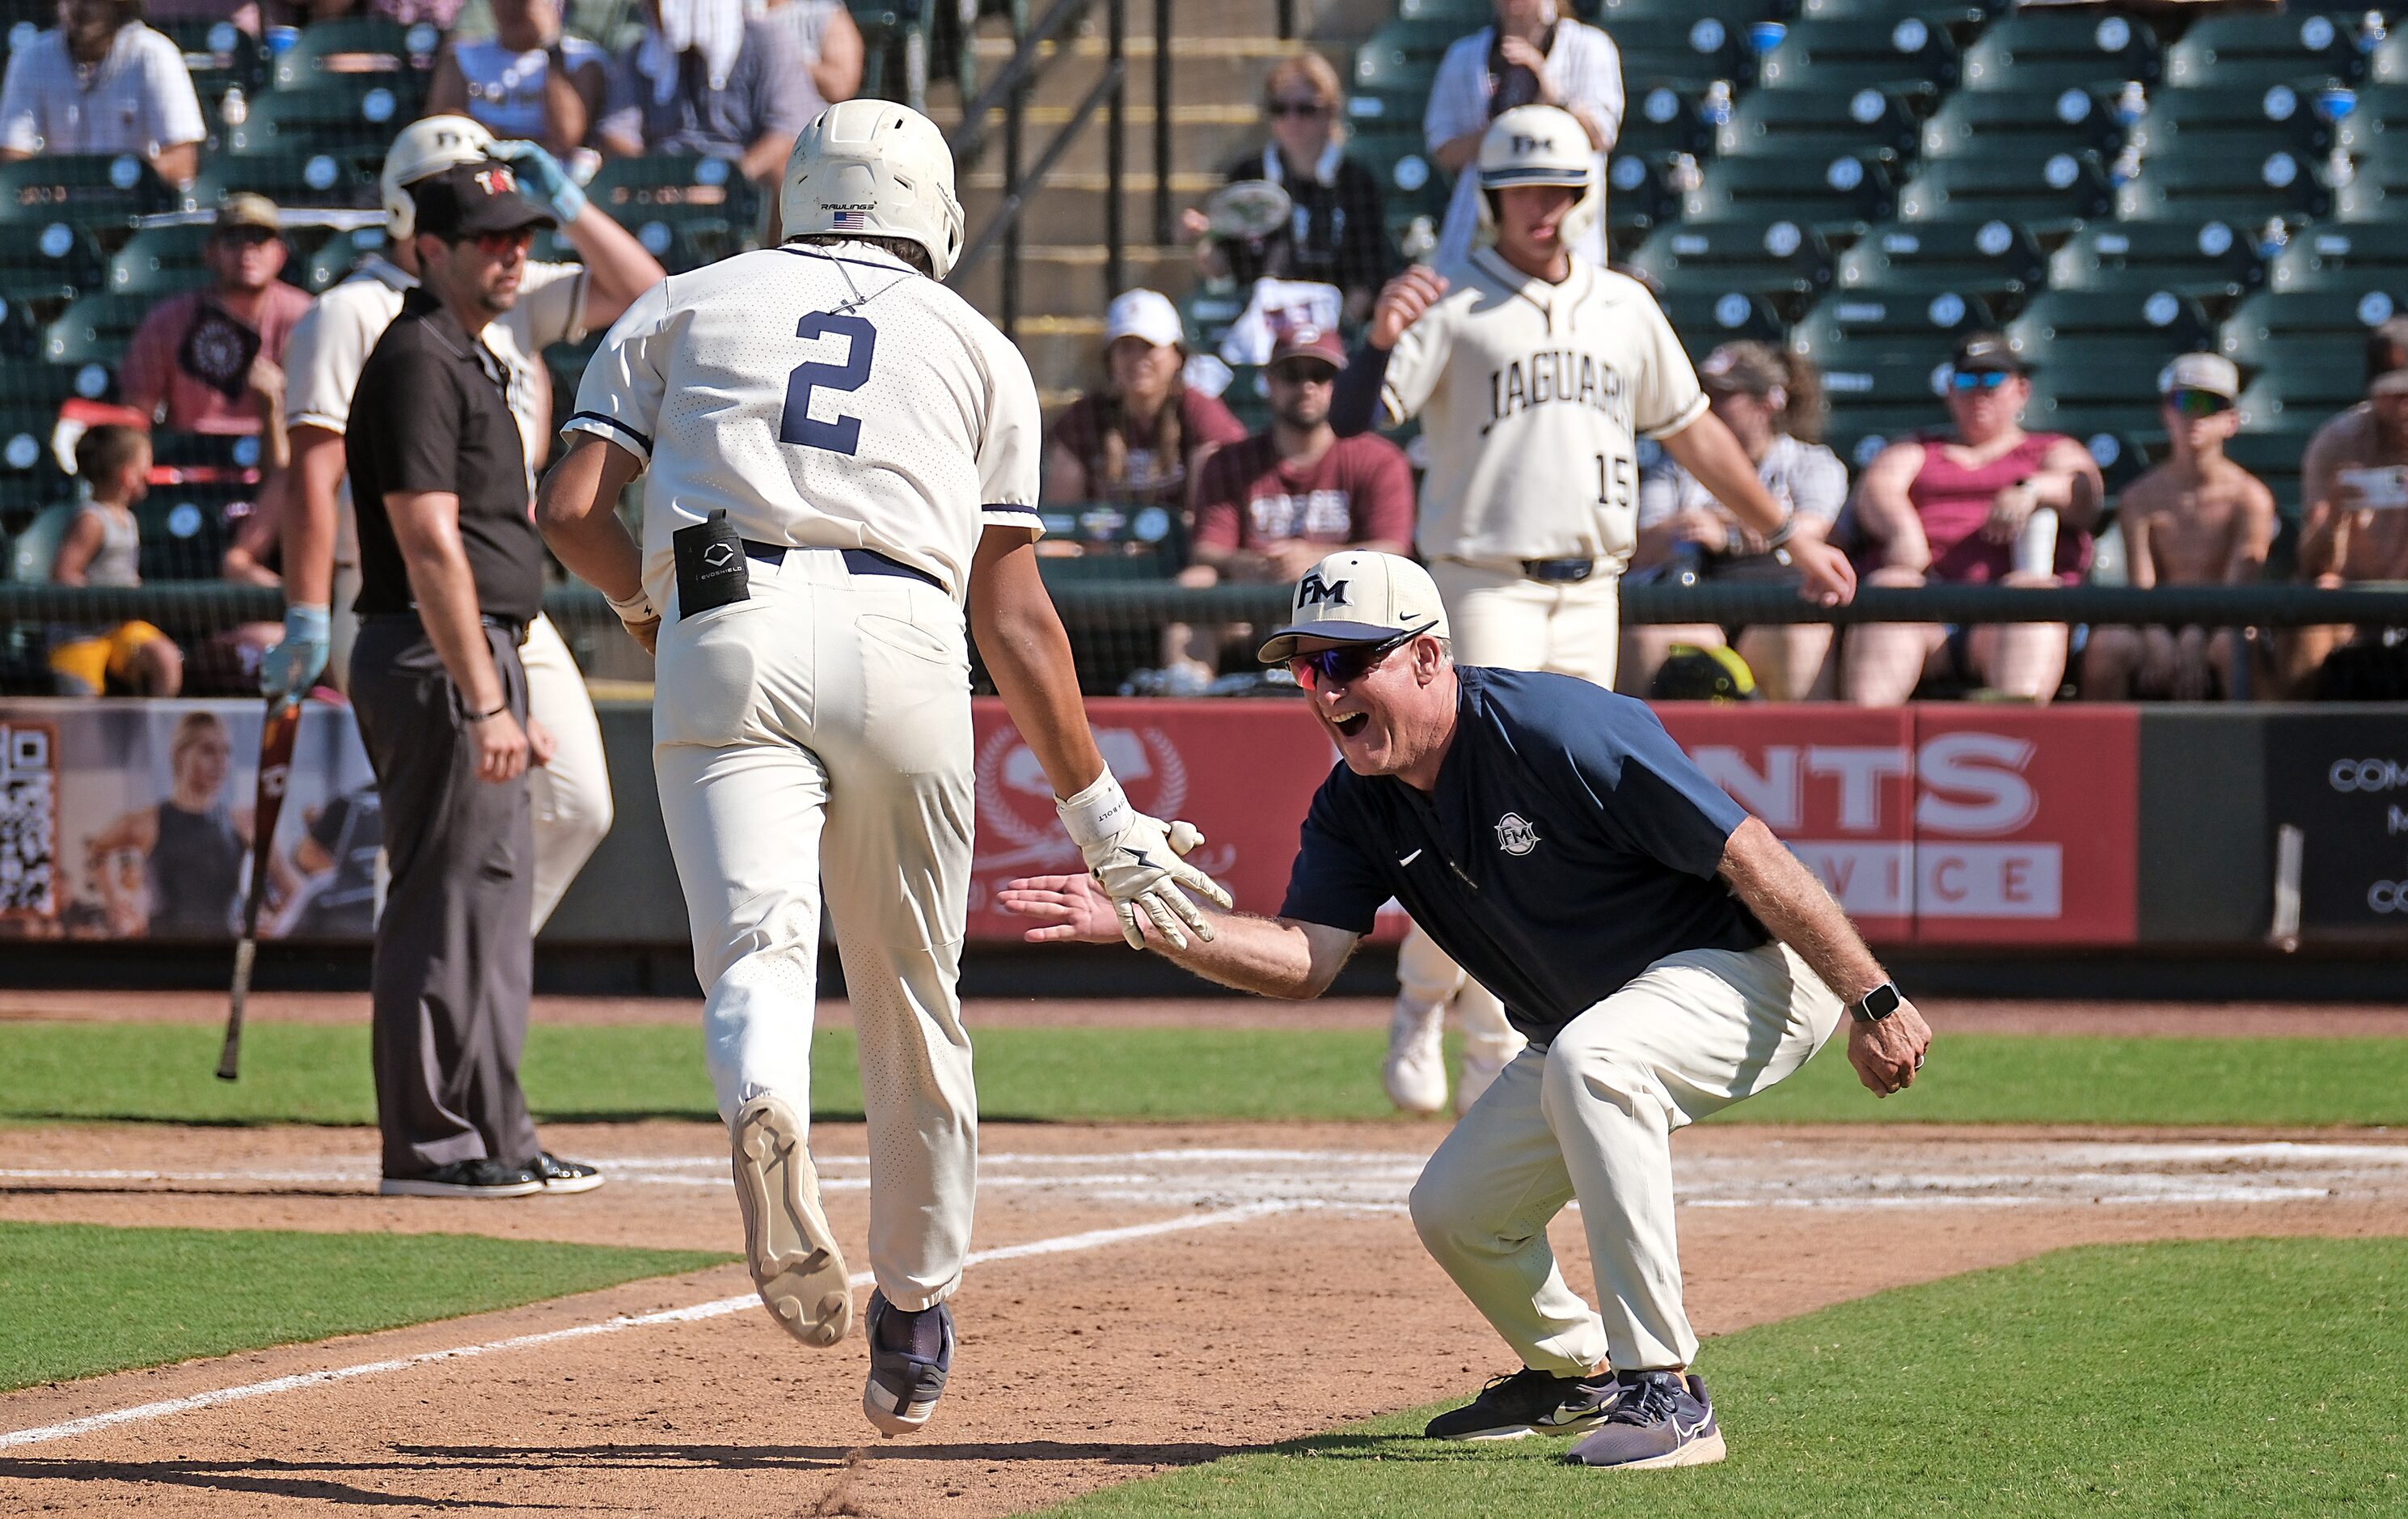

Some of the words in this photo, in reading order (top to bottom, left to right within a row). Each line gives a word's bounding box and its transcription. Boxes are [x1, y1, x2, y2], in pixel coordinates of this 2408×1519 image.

[779, 311, 877, 456] 2
[1596, 454, 1629, 506] 15
[1297, 572, 1354, 610] FM
[1688, 731, 2039, 836] NTS
[1099, 806, 1117, 822] BOLT
[1497, 824, 1536, 848] FM
[1822, 857, 2034, 903] VICE
